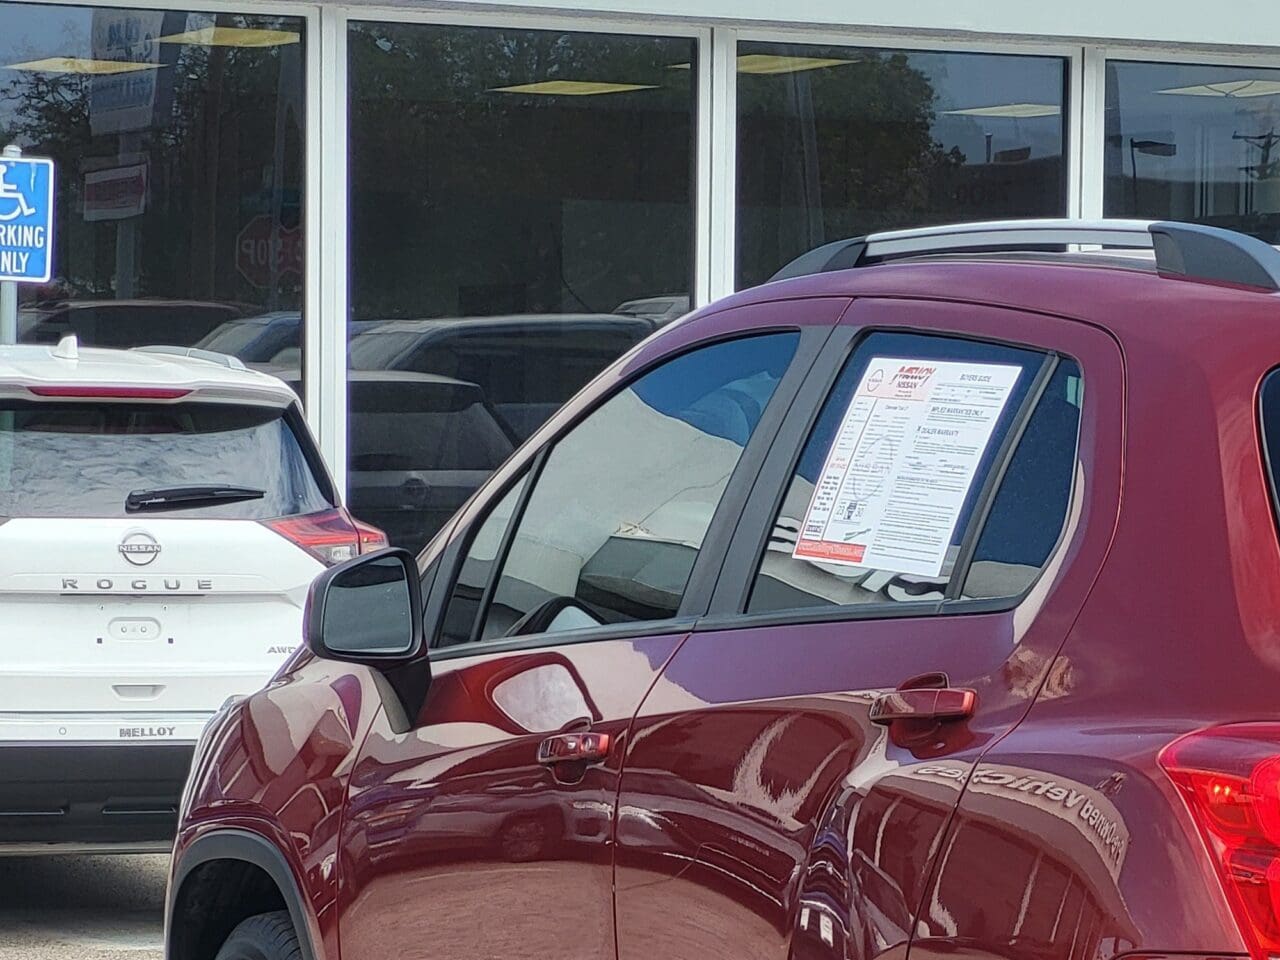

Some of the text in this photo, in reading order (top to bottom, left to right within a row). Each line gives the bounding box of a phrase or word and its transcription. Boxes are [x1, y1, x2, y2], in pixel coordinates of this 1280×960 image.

[119, 544, 161, 553] NISSAN
[61, 579, 213, 591] ROGUE
[119, 726, 176, 738] MELLOY
